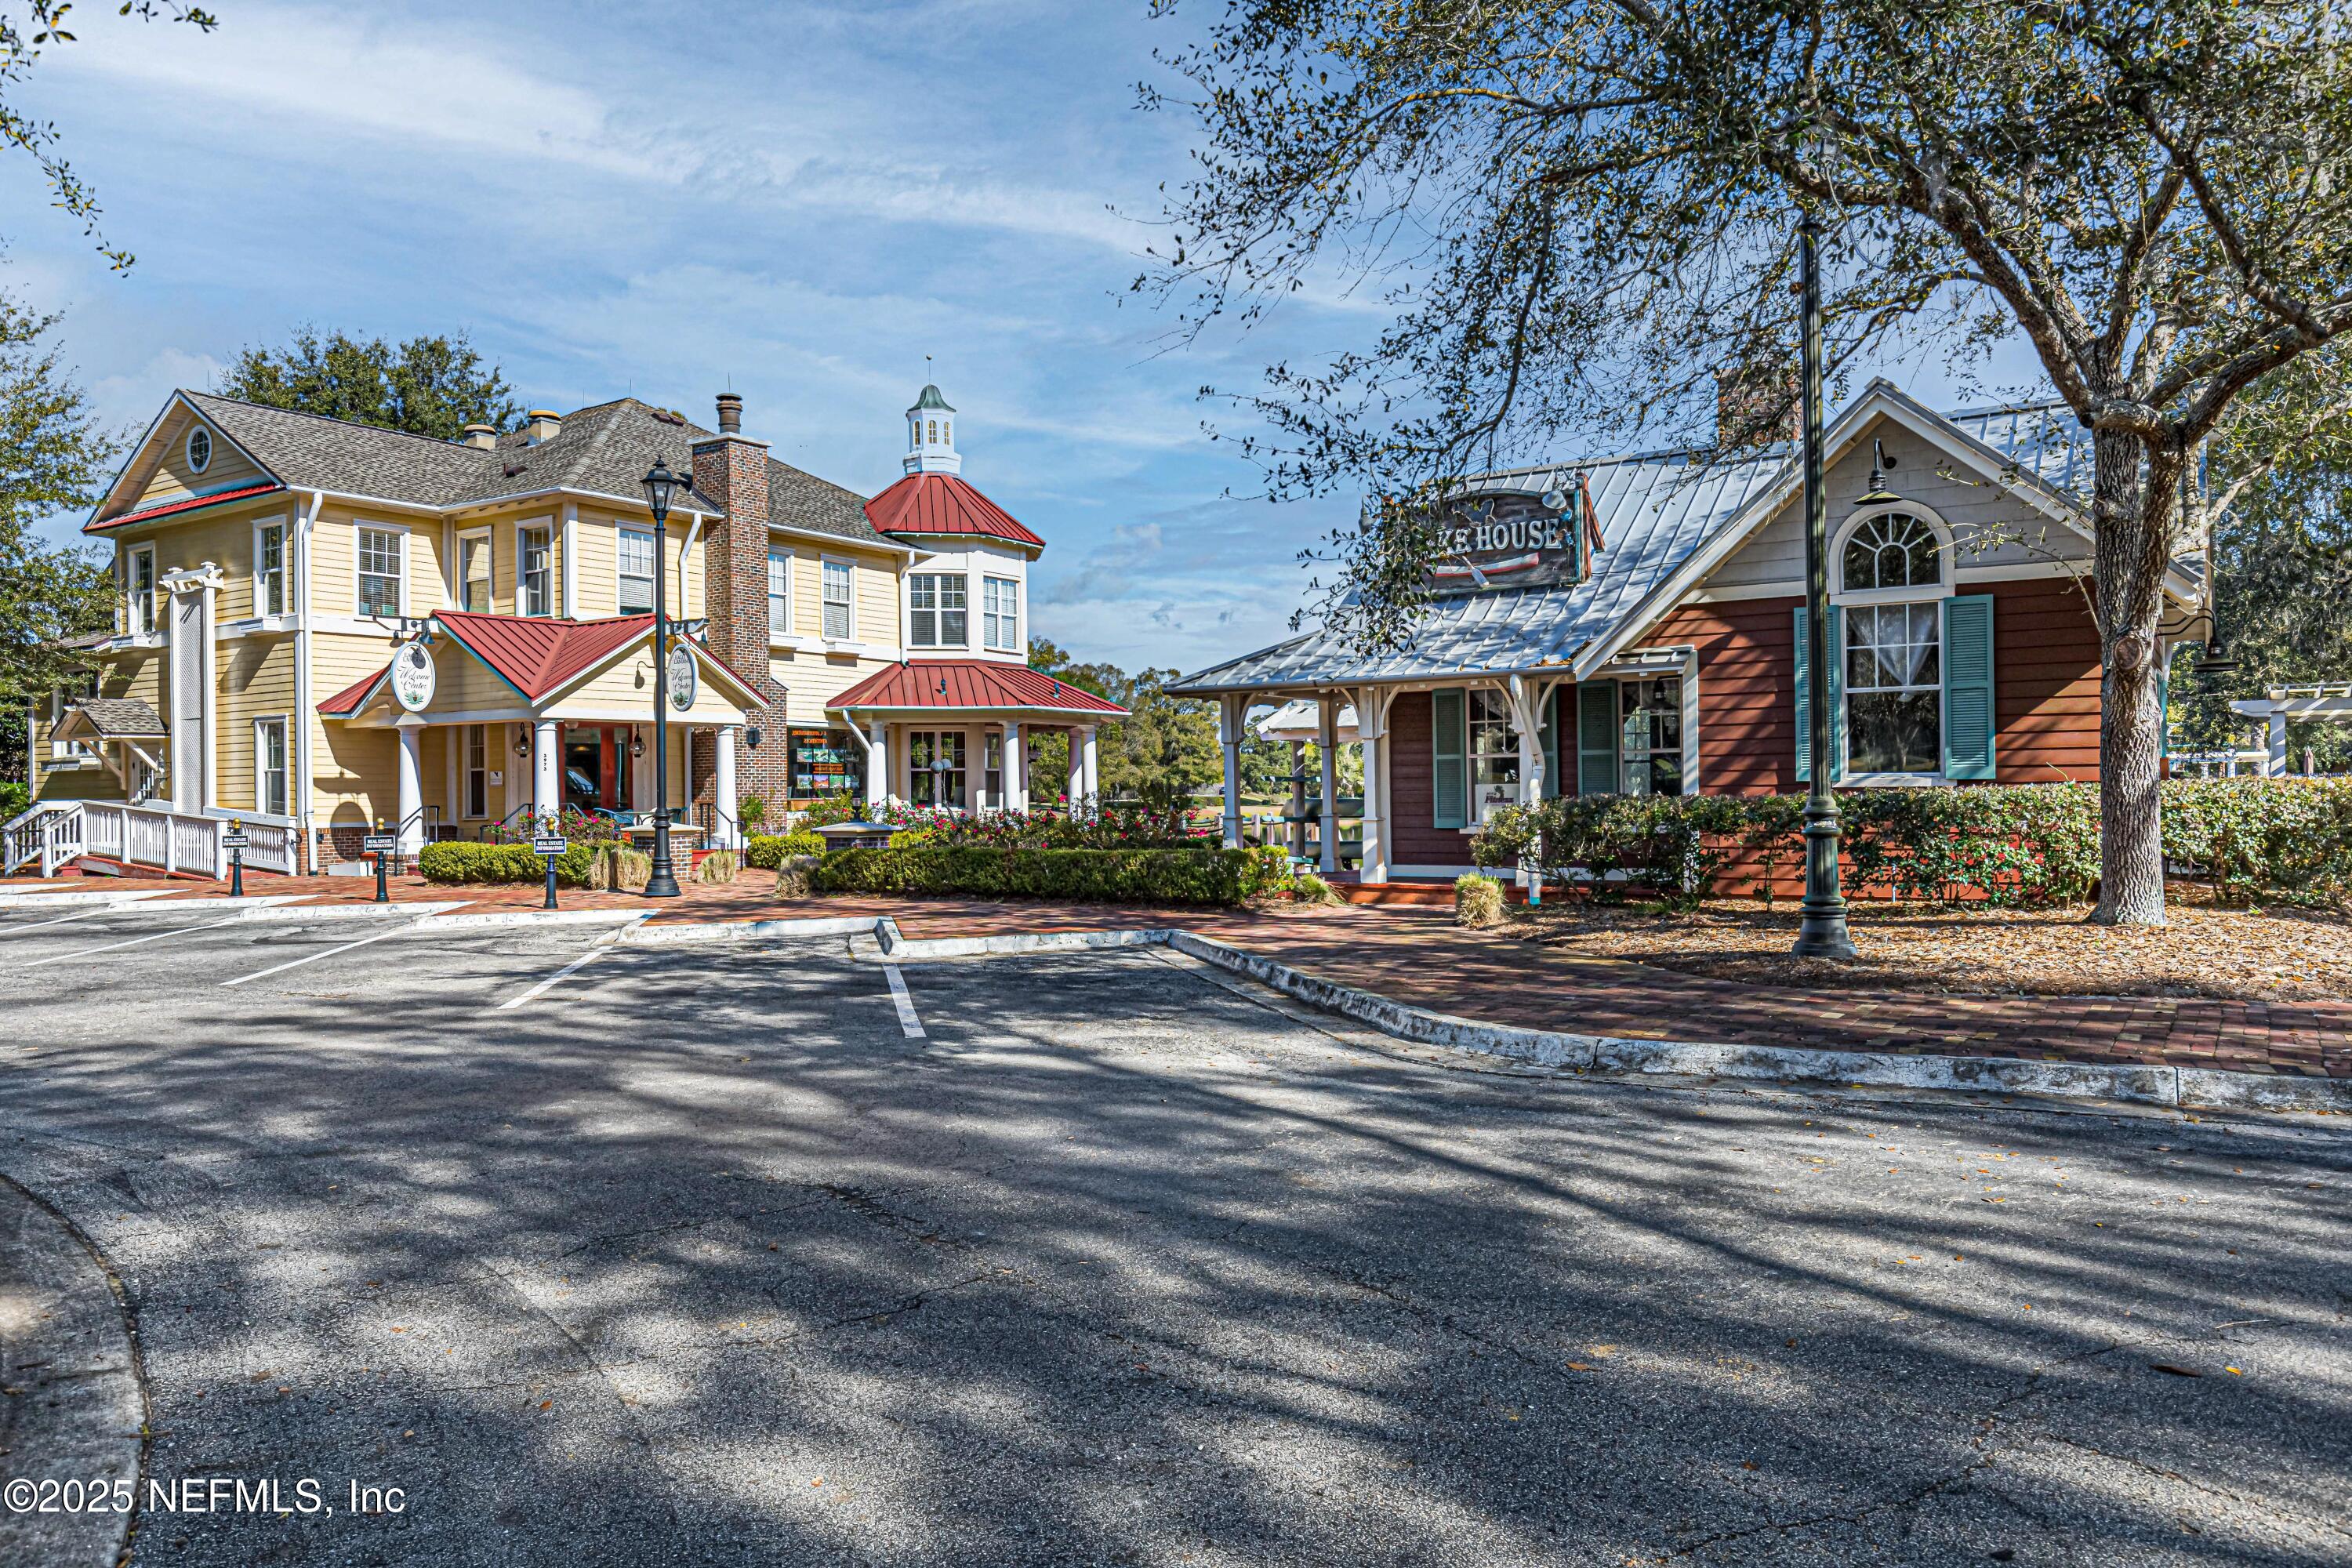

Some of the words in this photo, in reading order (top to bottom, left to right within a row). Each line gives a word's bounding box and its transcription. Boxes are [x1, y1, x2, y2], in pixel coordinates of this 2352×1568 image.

[1476, 518, 1562, 550] HOUSE
[397, 666, 430, 682] Welcome
[401, 680, 426, 691] Center
[673, 681, 691, 691] Center
